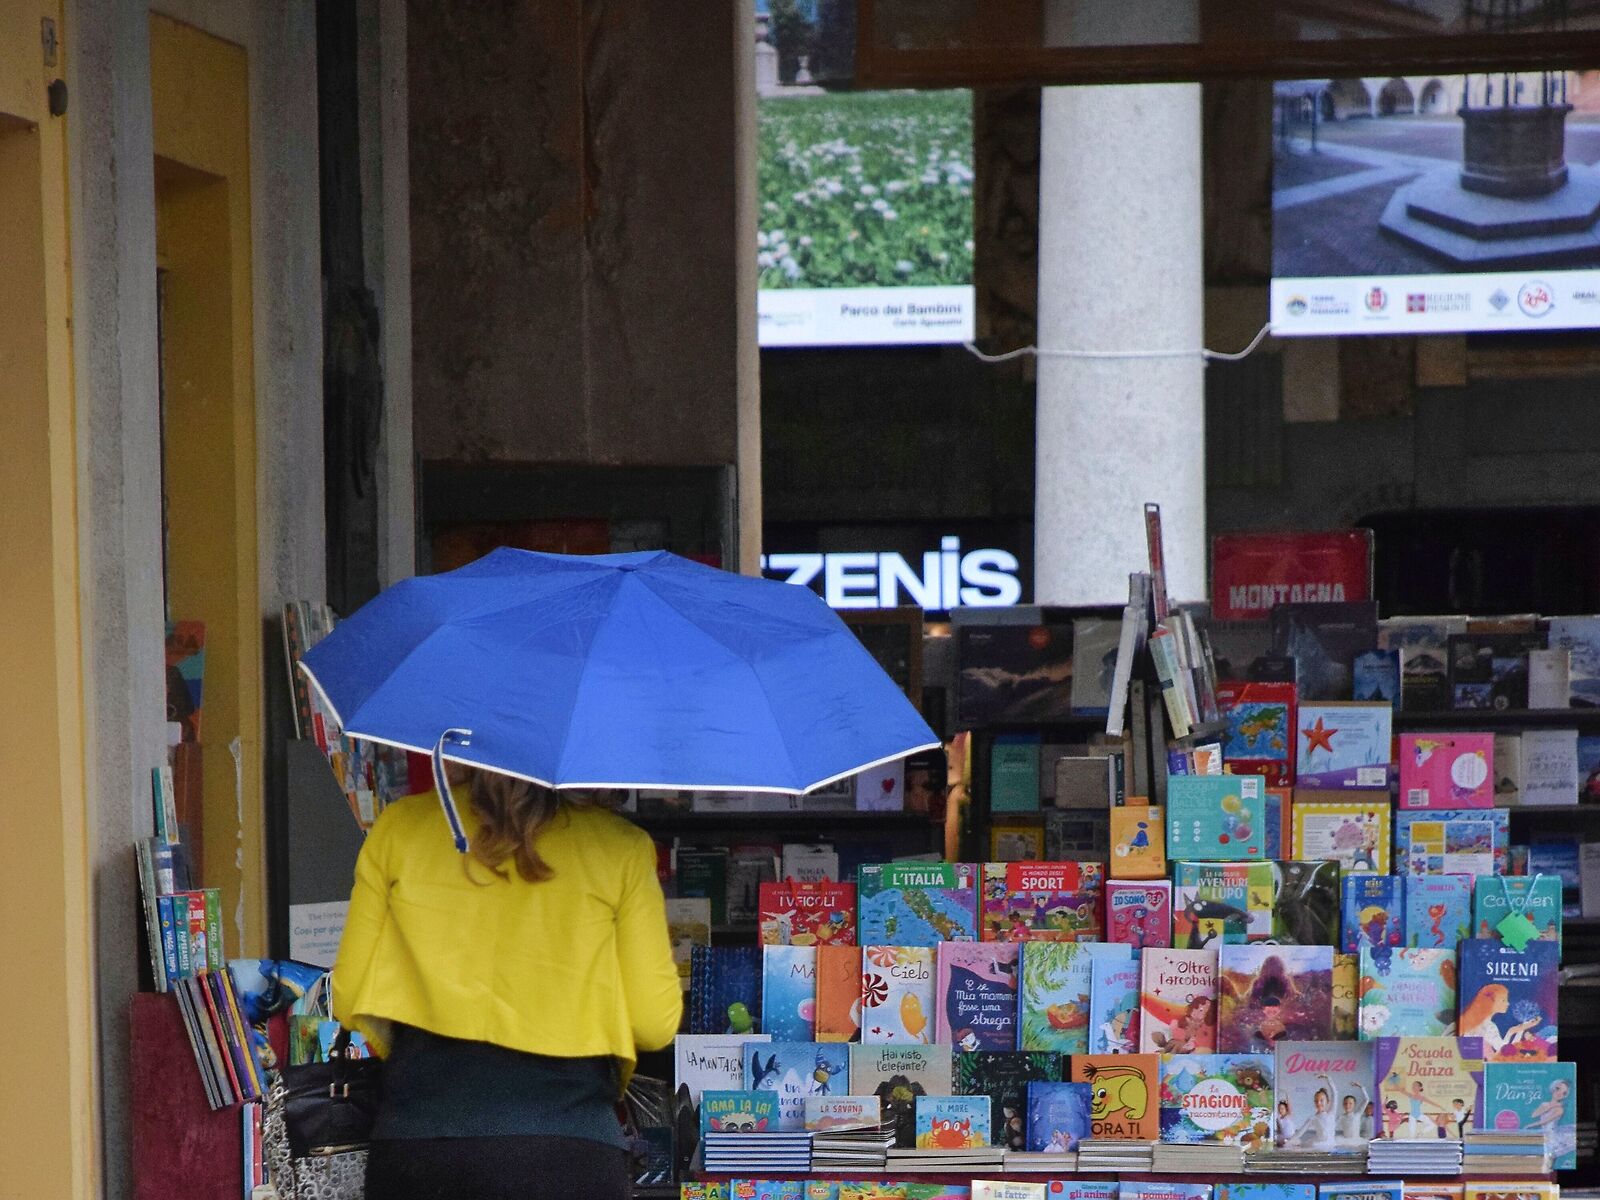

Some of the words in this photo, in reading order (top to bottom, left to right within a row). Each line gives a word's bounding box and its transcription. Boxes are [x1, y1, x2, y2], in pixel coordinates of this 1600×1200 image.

[840, 304, 879, 317] Parco
[882, 304, 902, 315] dei
[907, 303, 962, 315] Bambini
[1230, 583, 1346, 609] MONTAGNA
[892, 873, 945, 886] L'ITALIA
[1021, 877, 1065, 889] SPORT
[1113, 896, 1123, 906] IO
[1124, 894, 1146, 905] SONO
[1211, 887, 1244, 900] LUPO
[891, 960, 930, 980] Cielo
[1177, 961, 1211, 974] Oltre
[1486, 961, 1539, 976] SIRENA
[955, 990, 976, 1000] Mia
[881, 1049, 899, 1062] Hai
[900, 1049, 922, 1060] visto
[1408, 1043, 1454, 1059] Scuola
[685, 1050, 698, 1067] LA
[1284, 1052, 1357, 1075] Danza
[876, 1060, 927, 1073] l'elefante?
[1407, 1060, 1454, 1076] Danza
[1495, 1082, 1542, 1105] Danza
[706, 1099, 735, 1113] LAMA
[740, 1099, 752, 1111] LA
[820, 1104, 830, 1113] LA
[833, 1104, 864, 1114] SAVANA
[936, 1104, 943, 1113] IL
[947, 1104, 969, 1113] MARE
[1091, 1122, 1125, 1136] ORA
[1127, 1122, 1140, 1135] TI
[994, 1190, 1003, 1199] la
[1069, 1190, 1083, 1200] gli
